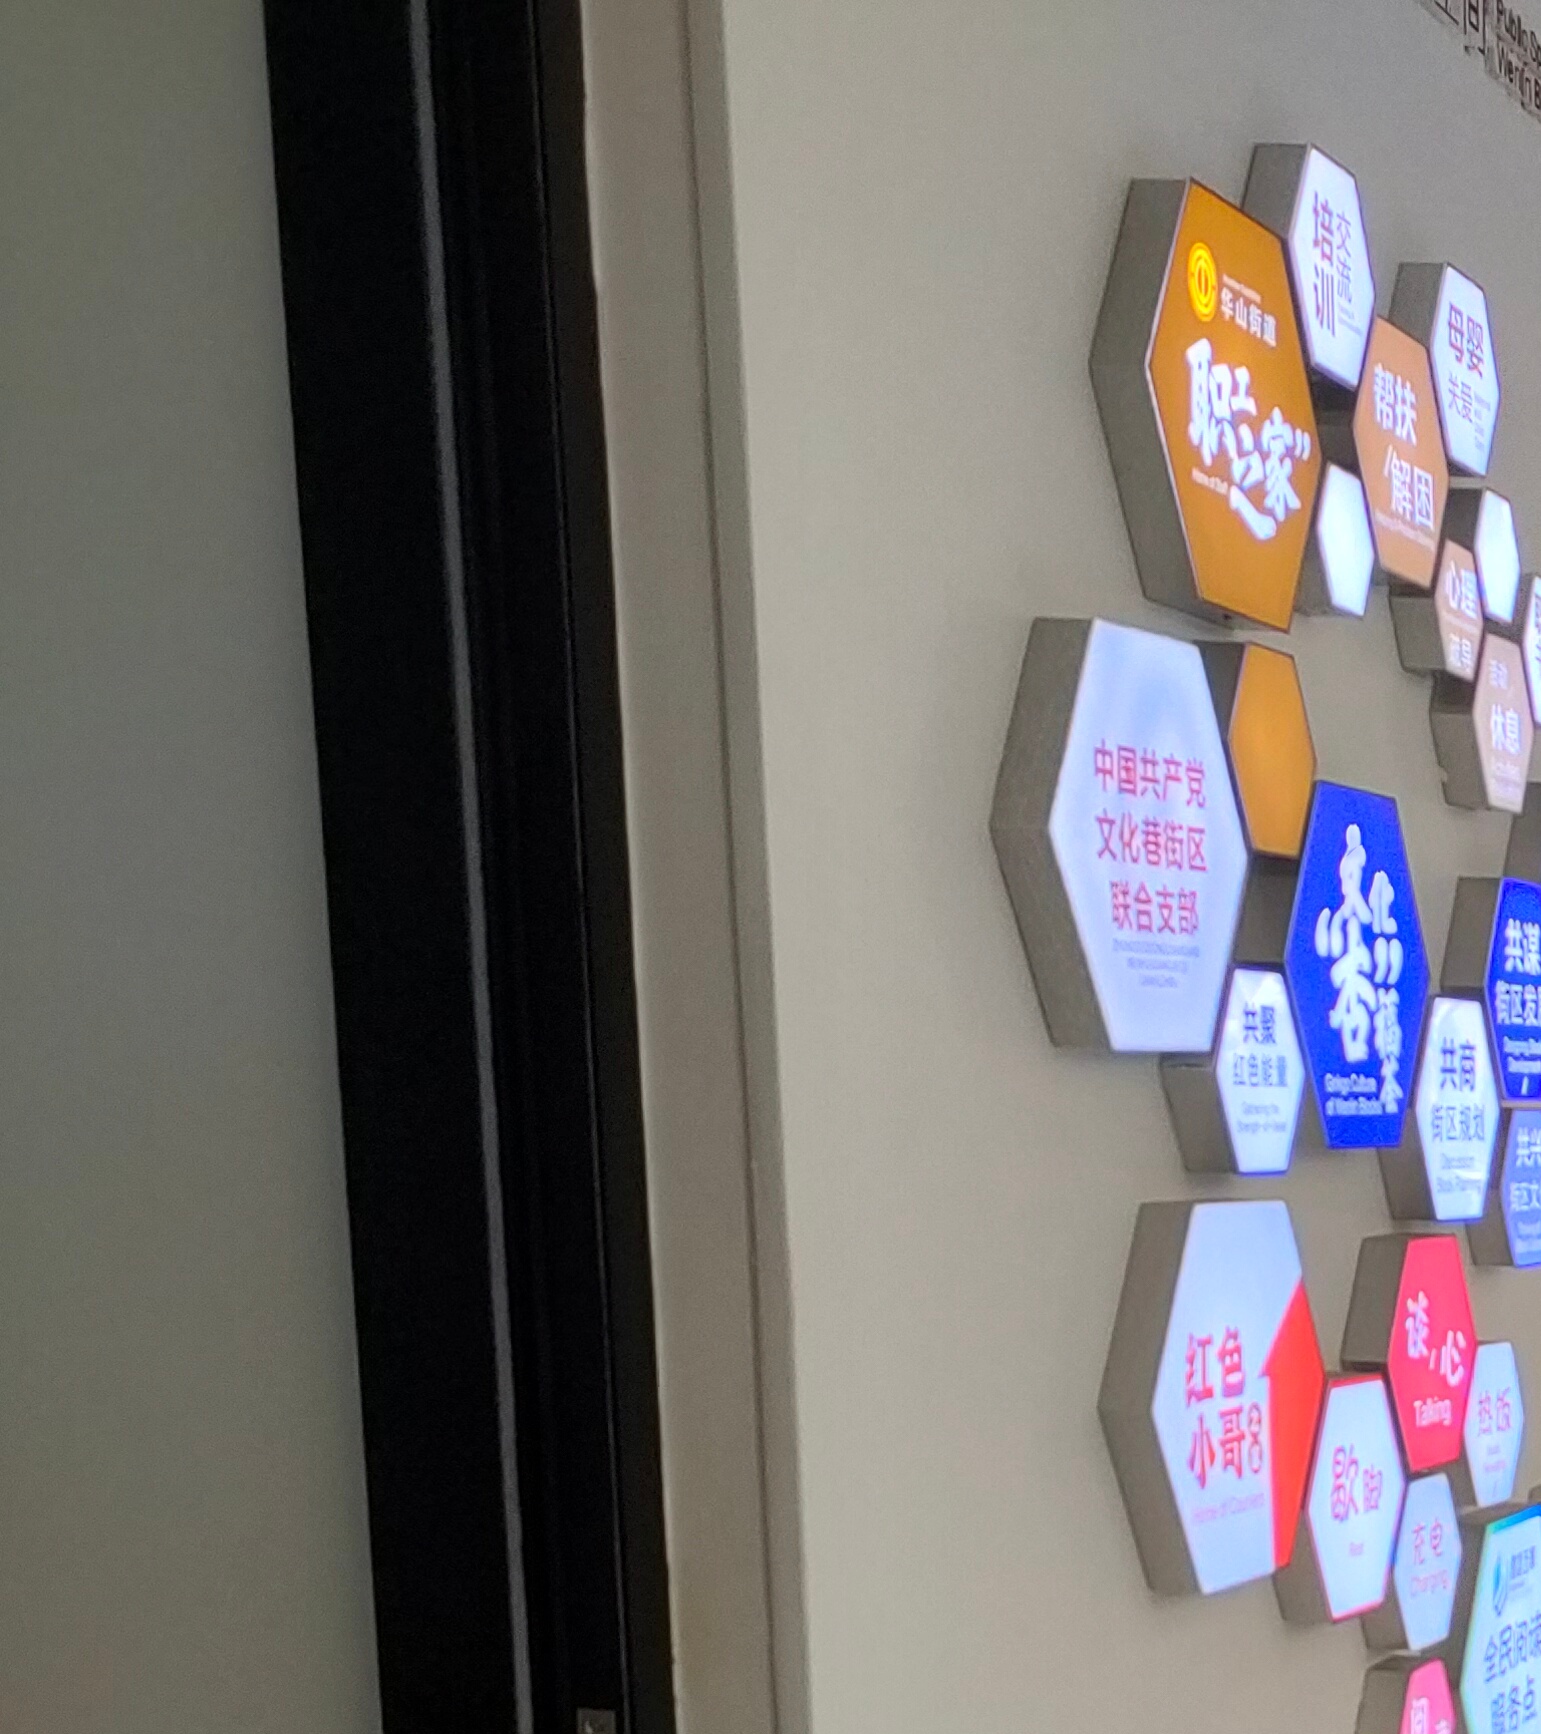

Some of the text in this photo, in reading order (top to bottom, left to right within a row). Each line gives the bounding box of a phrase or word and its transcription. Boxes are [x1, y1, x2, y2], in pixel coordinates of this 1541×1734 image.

[1312, 191, 1336, 337] 培训
[1221, 286, 1277, 348] 华山街道
[1447, 301, 1485, 378] 母婴
[1373, 362, 1417, 446] 帮扶
[1490, 704, 1521, 754] 休息
[1094, 739, 1206, 808] 中国共产党
[1095, 808, 1208, 872] 文化巷街区
[1110, 879, 1200, 935] 联合支部
[1503, 917, 1541, 976] 共谋
[1243, 1003, 1277, 1045] 共聚
[1233, 1053, 1288, 1088] 红色能量
[1440, 1037, 1477, 1092] 共商
[1432, 1104, 1486, 1144] 街区规划
[1185, 1327, 1246, 1407] 红色
[1413, 1397, 1452, 1428] Talking
[1188, 1404, 1246, 1490] 小哥
[1331, 1444, 1383, 1524] 歇脚
[1411, 1516, 1445, 1565] 充电
[1410, 1565, 1451, 1600] Charging
